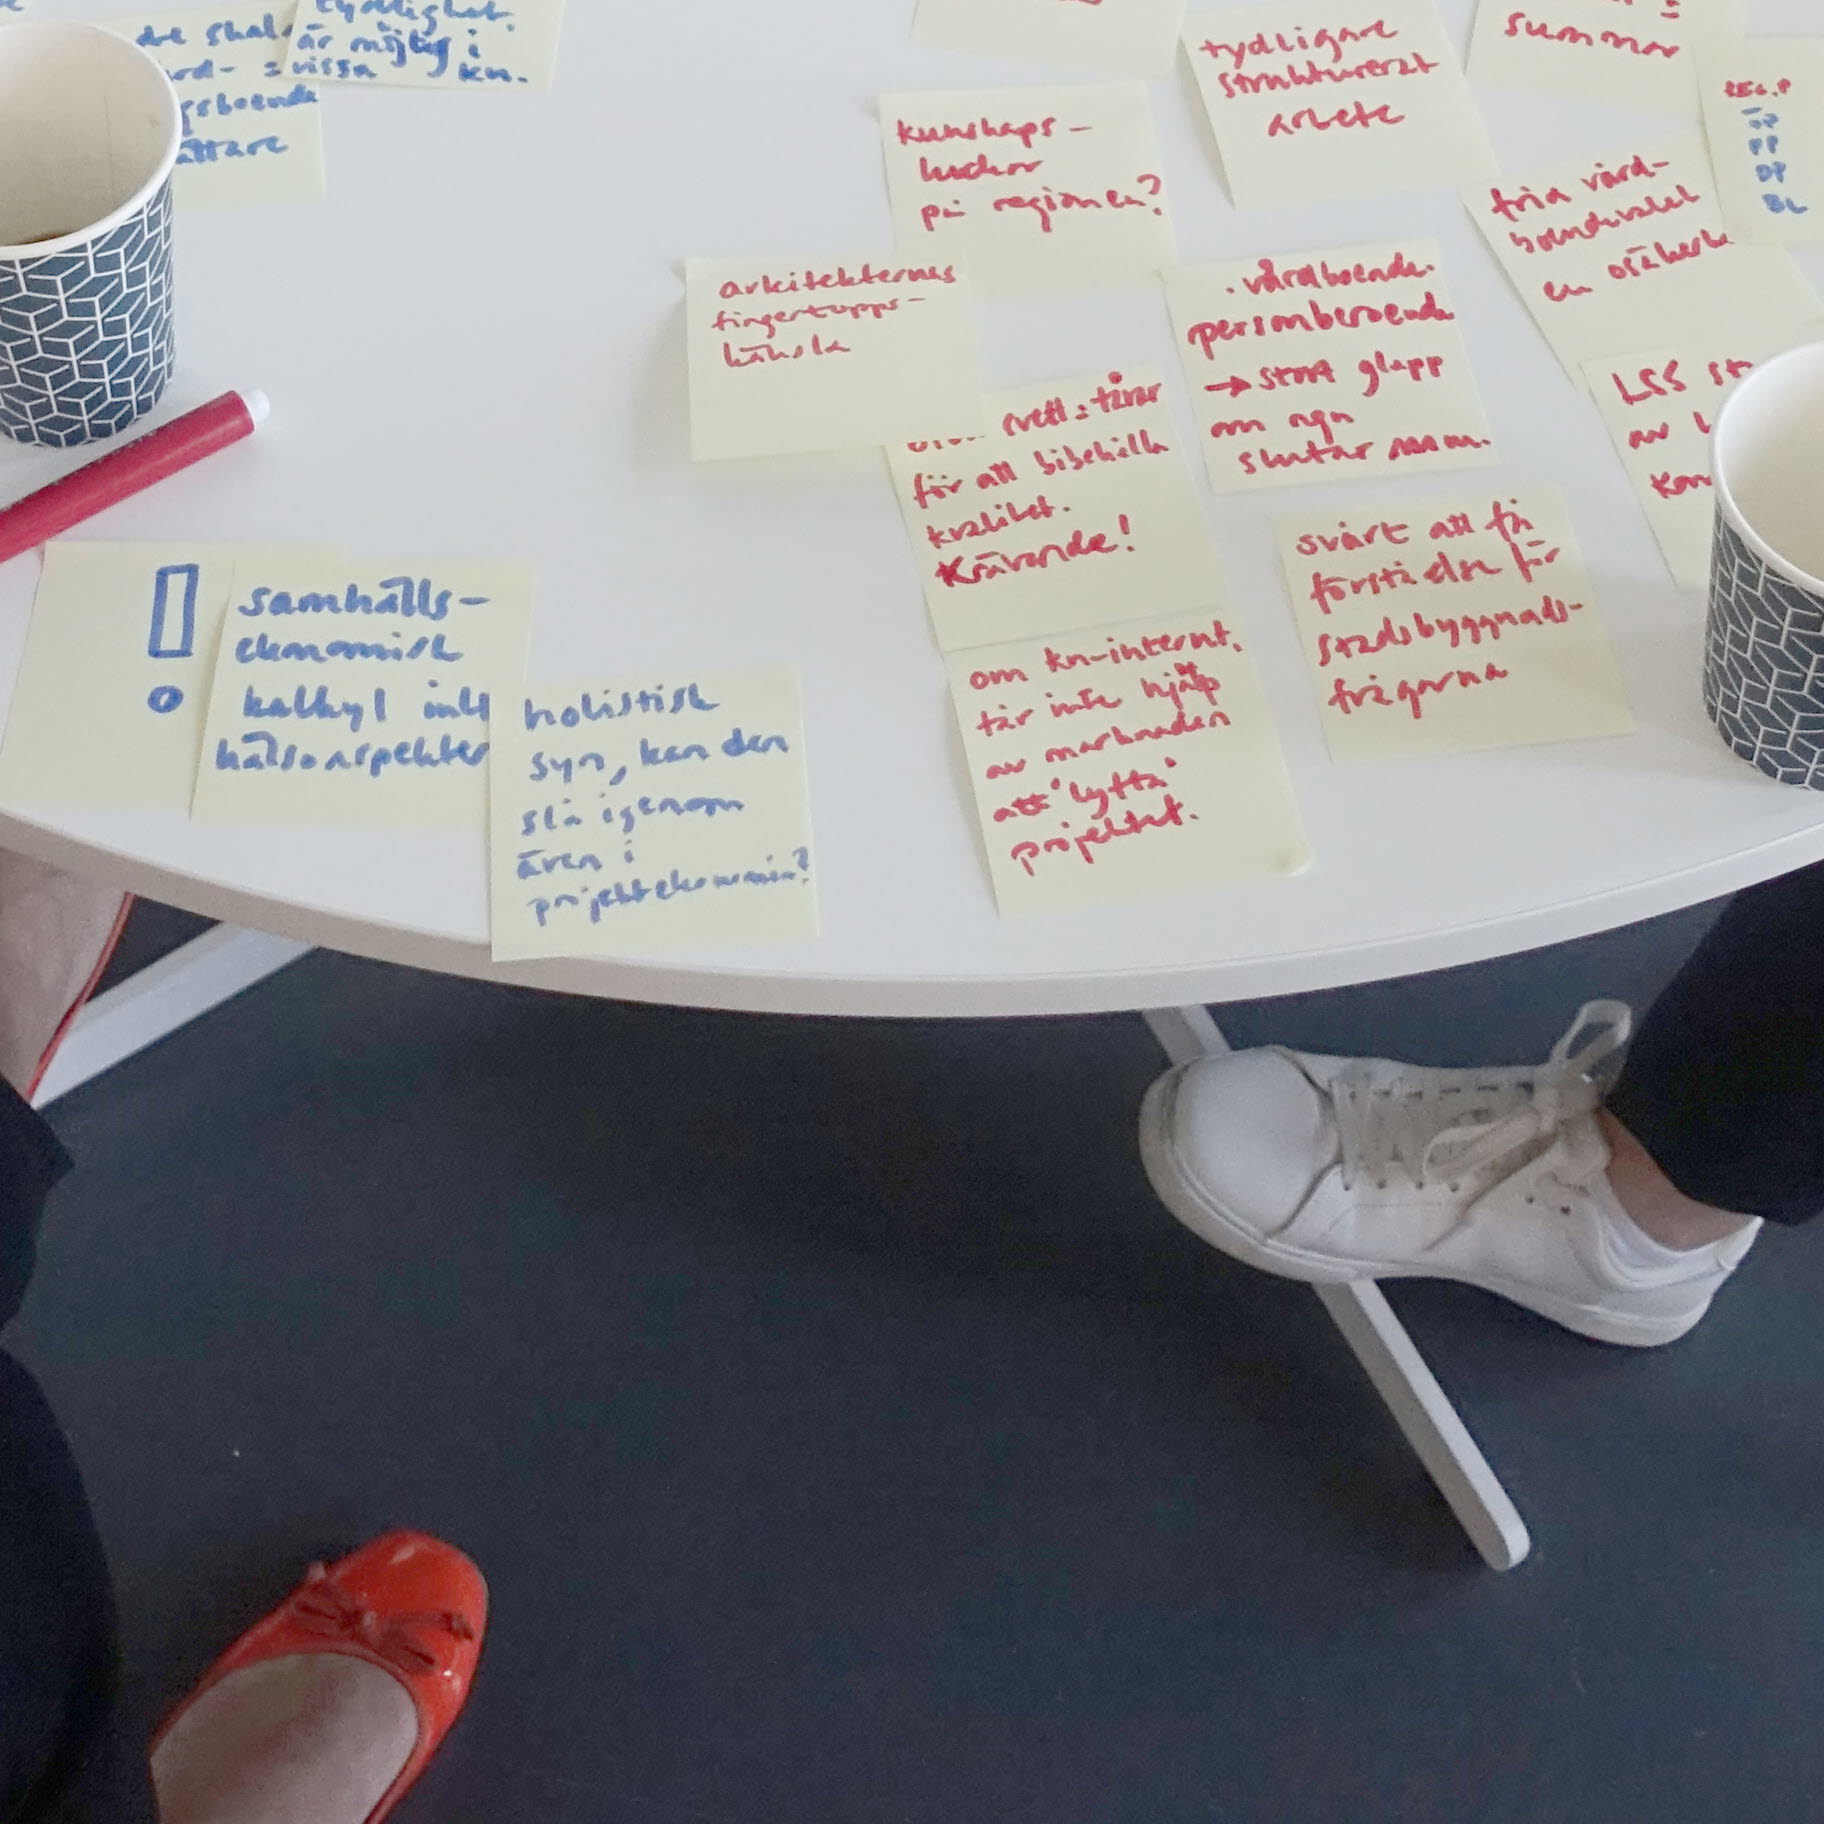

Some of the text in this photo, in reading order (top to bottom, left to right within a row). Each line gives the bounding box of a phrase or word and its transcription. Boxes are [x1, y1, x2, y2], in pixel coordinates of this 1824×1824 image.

[296, 22, 335, 51] är
[1199, 18, 1400, 71] tydligare
[292, 56, 379, 78] vissa
[896, 116, 1094, 150] kunskaps-
[1489, 153, 1672, 223] fria vård-
[920, 198, 967, 233] på
[718, 262, 957, 300] arkitekternas
[1542, 280, 1595, 302] en
[722, 333, 852, 369] känsla
[1357, 348, 1445, 399] glapp
[1611, 358, 1688, 407] LSS
[1209, 417, 1267, 439] om
[1238, 438, 1375, 476] slutar
[912, 472, 964, 511] för
[975, 459, 1019, 491] att
[1295, 496, 1536, 557] svårt att få
[237, 575, 491, 622] samhälls-
[234, 631, 465, 665] ekonomisk
[968, 667, 1030, 691] om
[242, 684, 388, 734] kalkyl
[523, 681, 722, 732] holistisk
[1043, 687, 1125, 719] inte
[721, 726, 790, 758] den
[985, 756, 1028, 780] av
[521, 797, 584, 837] slå
[992, 791, 1052, 823] att
[516, 848, 604, 881] även
